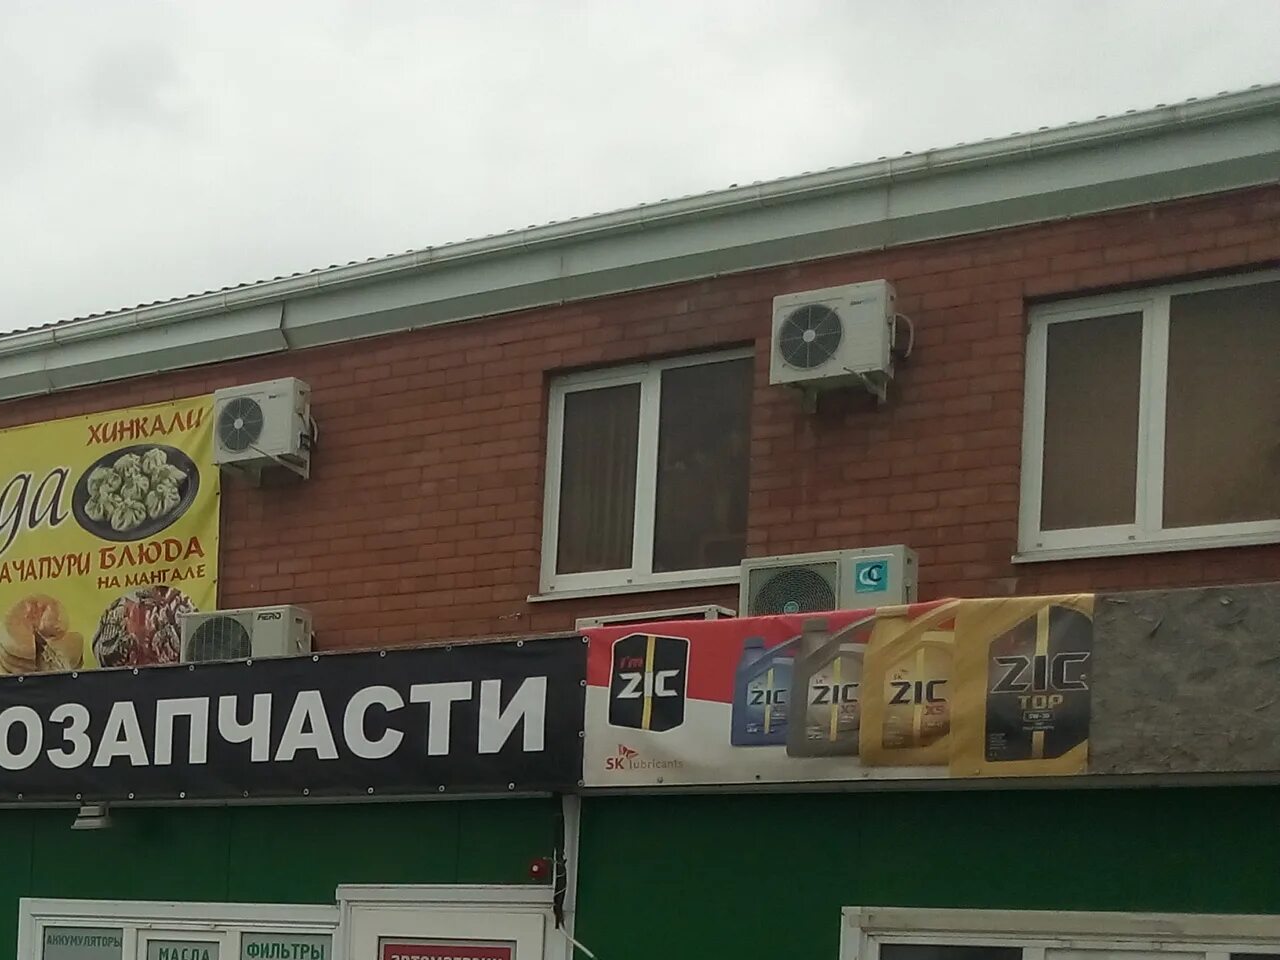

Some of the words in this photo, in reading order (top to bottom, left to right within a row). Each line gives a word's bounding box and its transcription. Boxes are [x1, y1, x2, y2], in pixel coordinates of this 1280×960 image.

[85, 407, 204, 446] ХИНКАЛИ
[98, 536, 205, 571] БЛЮДА
[96, 574, 120, 590] НА
[124, 563, 206, 588] МАНГАЛЕ
[617, 669, 680, 698] ZIC
[990, 652, 1090, 693] ZIC
[750, 689, 787, 705] ZIC
[812, 684, 859, 704] ZIC
[888, 680, 949, 705] ZIC
[1018, 695, 1063, 709] TOP
[606, 757, 624, 770] SK
[629, 759, 684, 770] lubricants
[246, 943, 325, 960] ФИЛЬТРЫ
